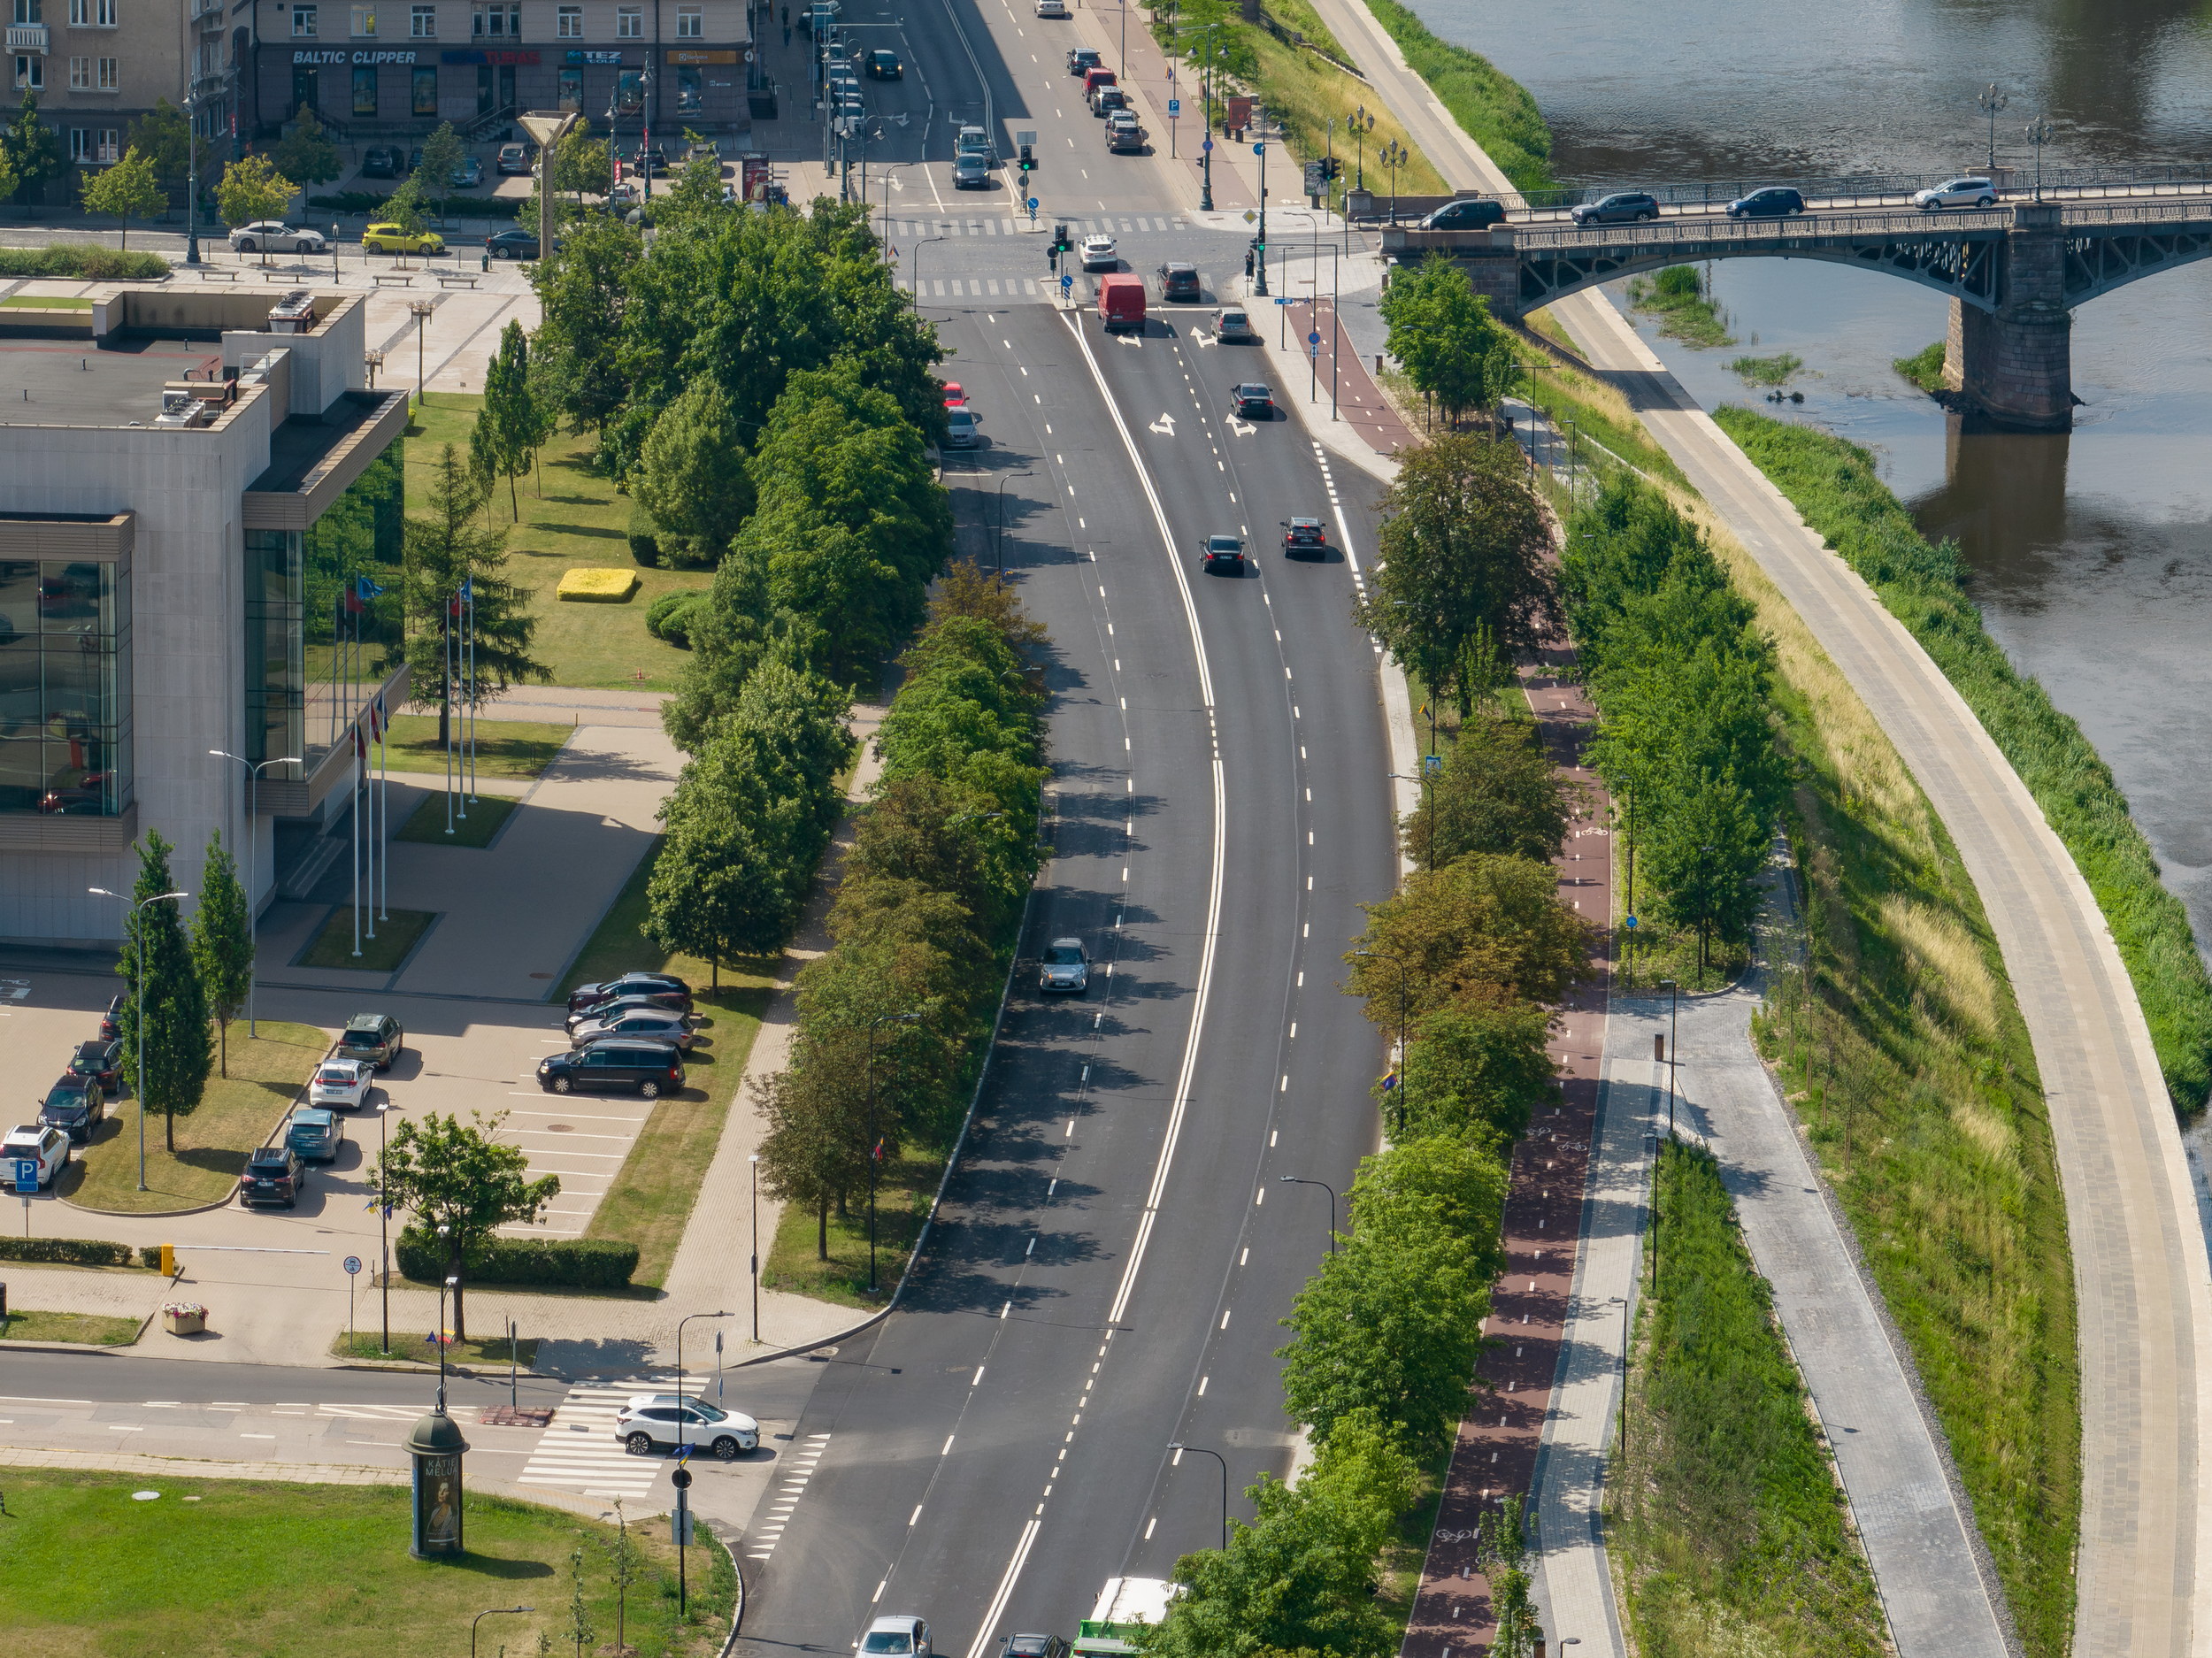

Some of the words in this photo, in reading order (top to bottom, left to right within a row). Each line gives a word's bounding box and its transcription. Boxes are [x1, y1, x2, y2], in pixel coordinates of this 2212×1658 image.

[293, 51, 345, 63] BALTIC
[352, 51, 416, 63] CLIPPER
[1171, 100, 1179, 110] P
[21, 1162, 34, 1179] P
[428, 1458, 456, 1468] KATIE
